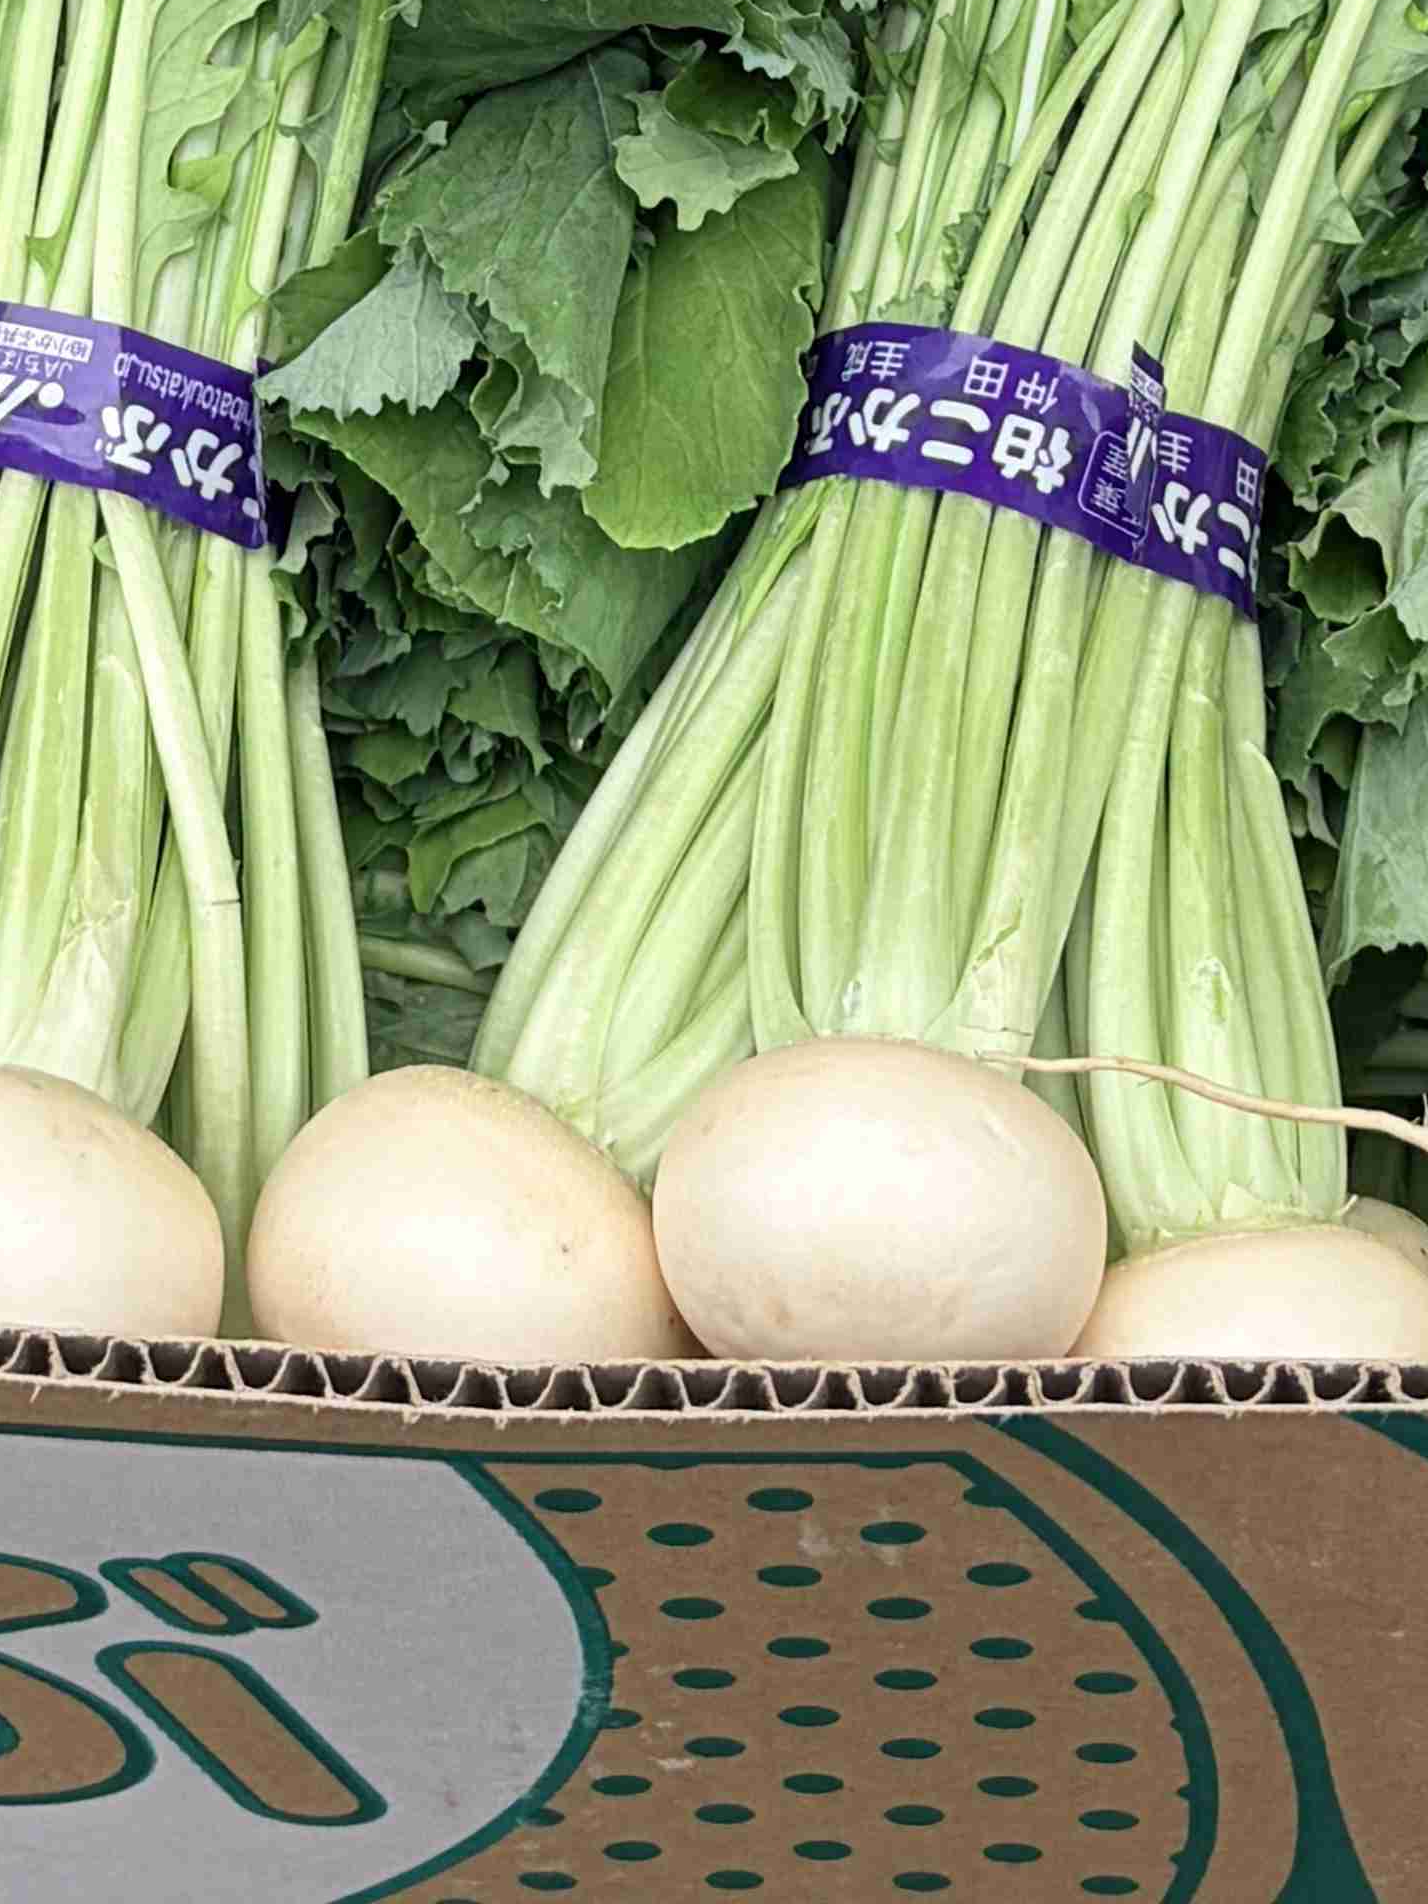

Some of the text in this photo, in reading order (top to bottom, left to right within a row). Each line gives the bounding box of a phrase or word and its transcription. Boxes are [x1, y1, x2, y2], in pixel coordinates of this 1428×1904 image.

[962, 355, 1061, 416] 仲田
[94, 403, 266, 520] かぶ
[803, 387, 1073, 494] 柏こかぶ
